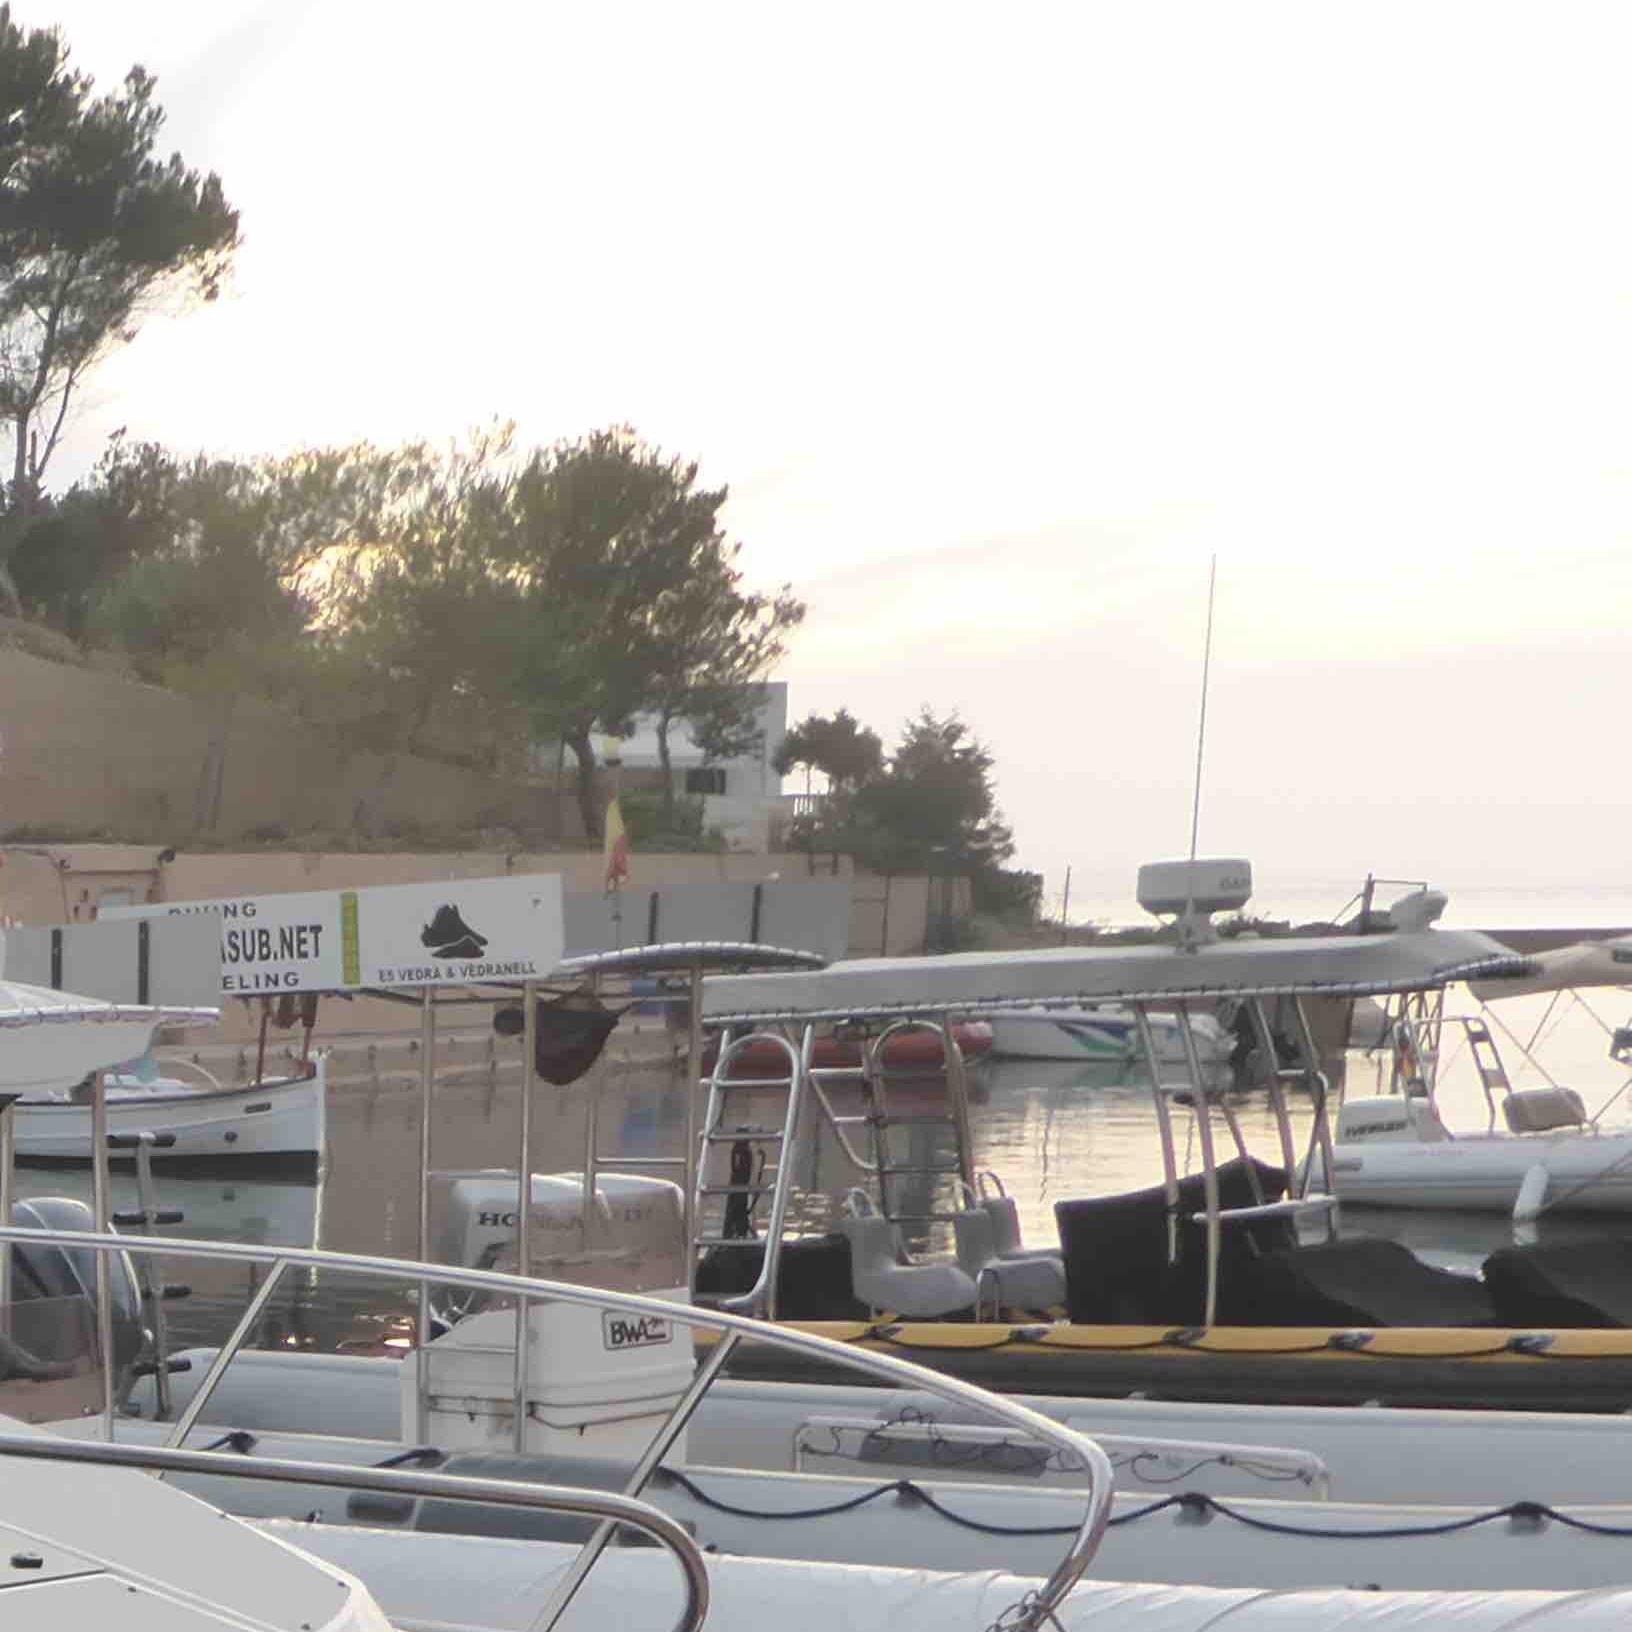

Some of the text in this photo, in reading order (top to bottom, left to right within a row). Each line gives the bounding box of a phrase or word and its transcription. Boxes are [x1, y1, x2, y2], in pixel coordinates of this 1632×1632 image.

[221, 925, 323, 964] SUB.NET
[464, 960, 536, 979] VEDRANELL
[222, 971, 300, 990] ELING
